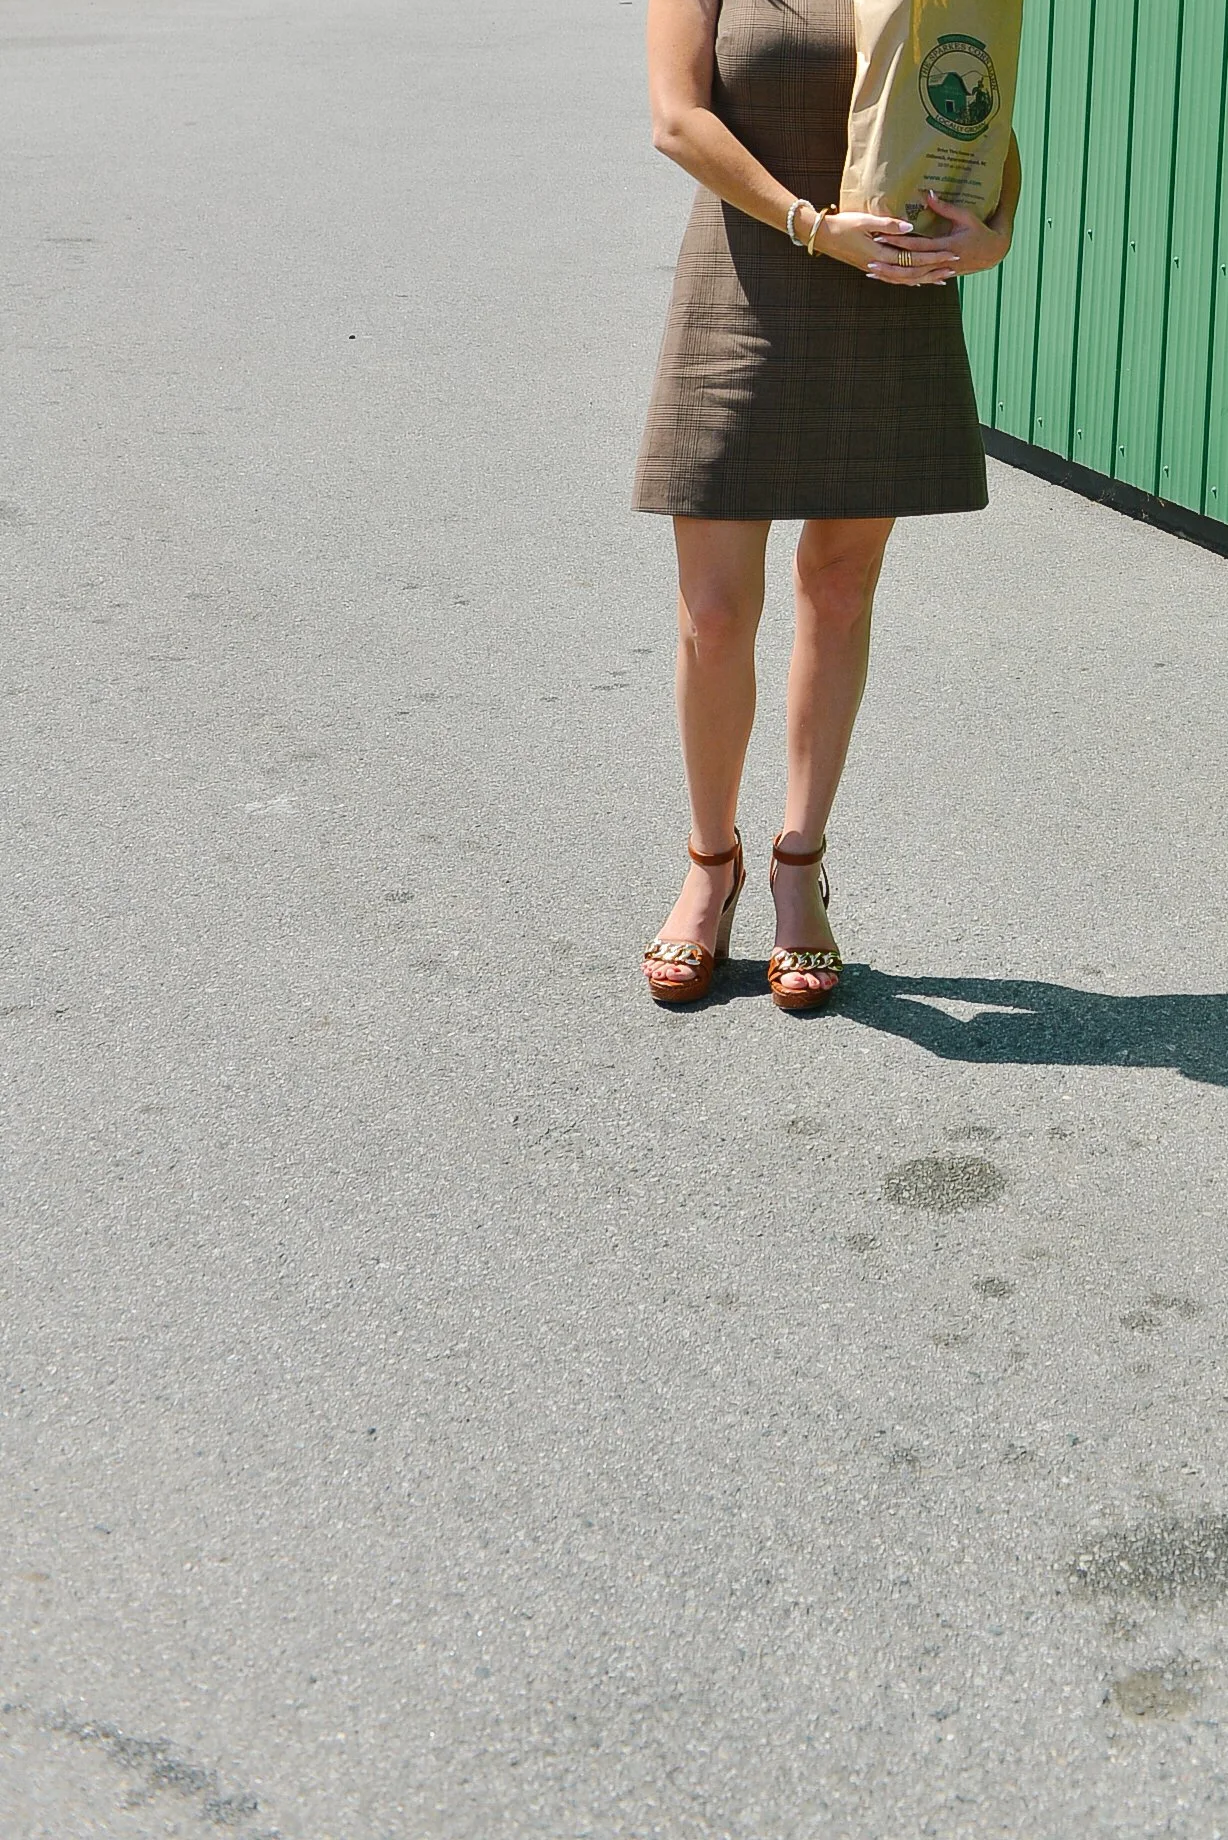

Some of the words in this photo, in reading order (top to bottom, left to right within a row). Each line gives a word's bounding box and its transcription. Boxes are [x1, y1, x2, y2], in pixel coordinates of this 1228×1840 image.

[920, 61, 931, 78] THE
[929, 43, 966, 61] SPARKES
[968, 45, 990, 64] CORN
[936, 115, 964, 131] LOCALLY
